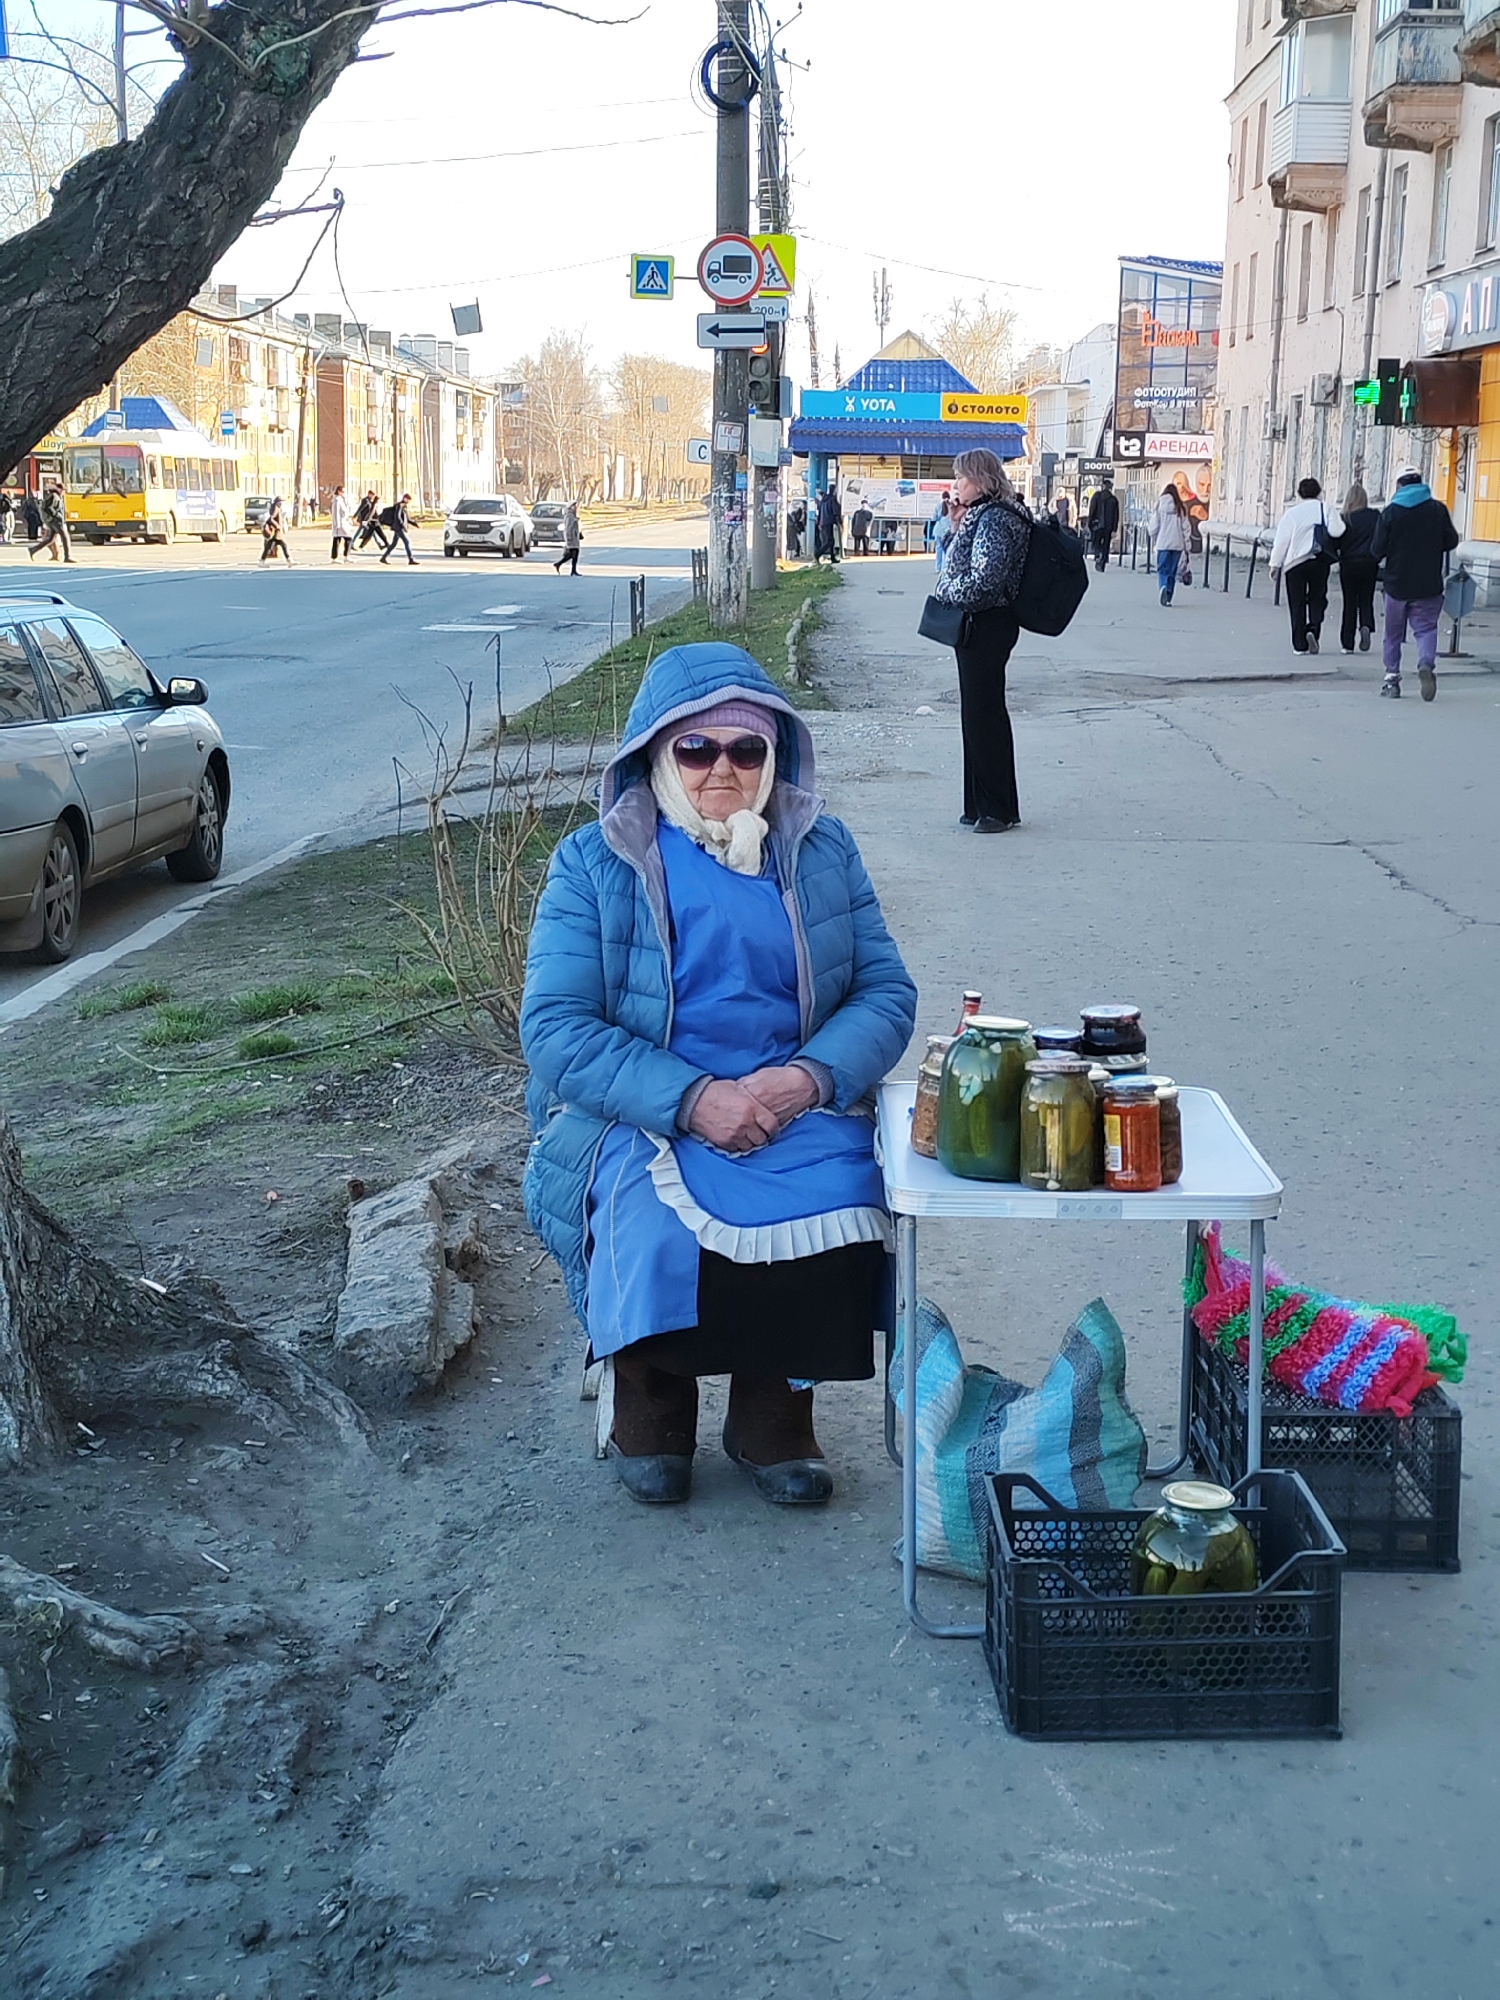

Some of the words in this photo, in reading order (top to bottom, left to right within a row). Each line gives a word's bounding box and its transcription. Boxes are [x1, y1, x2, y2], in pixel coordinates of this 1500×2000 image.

[1460, 275, 1499, 336] АП
[1134, 387, 1197, 398] ФОТОСТУДИЯ
[860, 398, 896, 411] YOTA
[961, 403, 1020, 415] СТОЛОТО
[1119, 436, 1141, 457] t2
[1148, 439, 1209, 455] АРЕНДА
